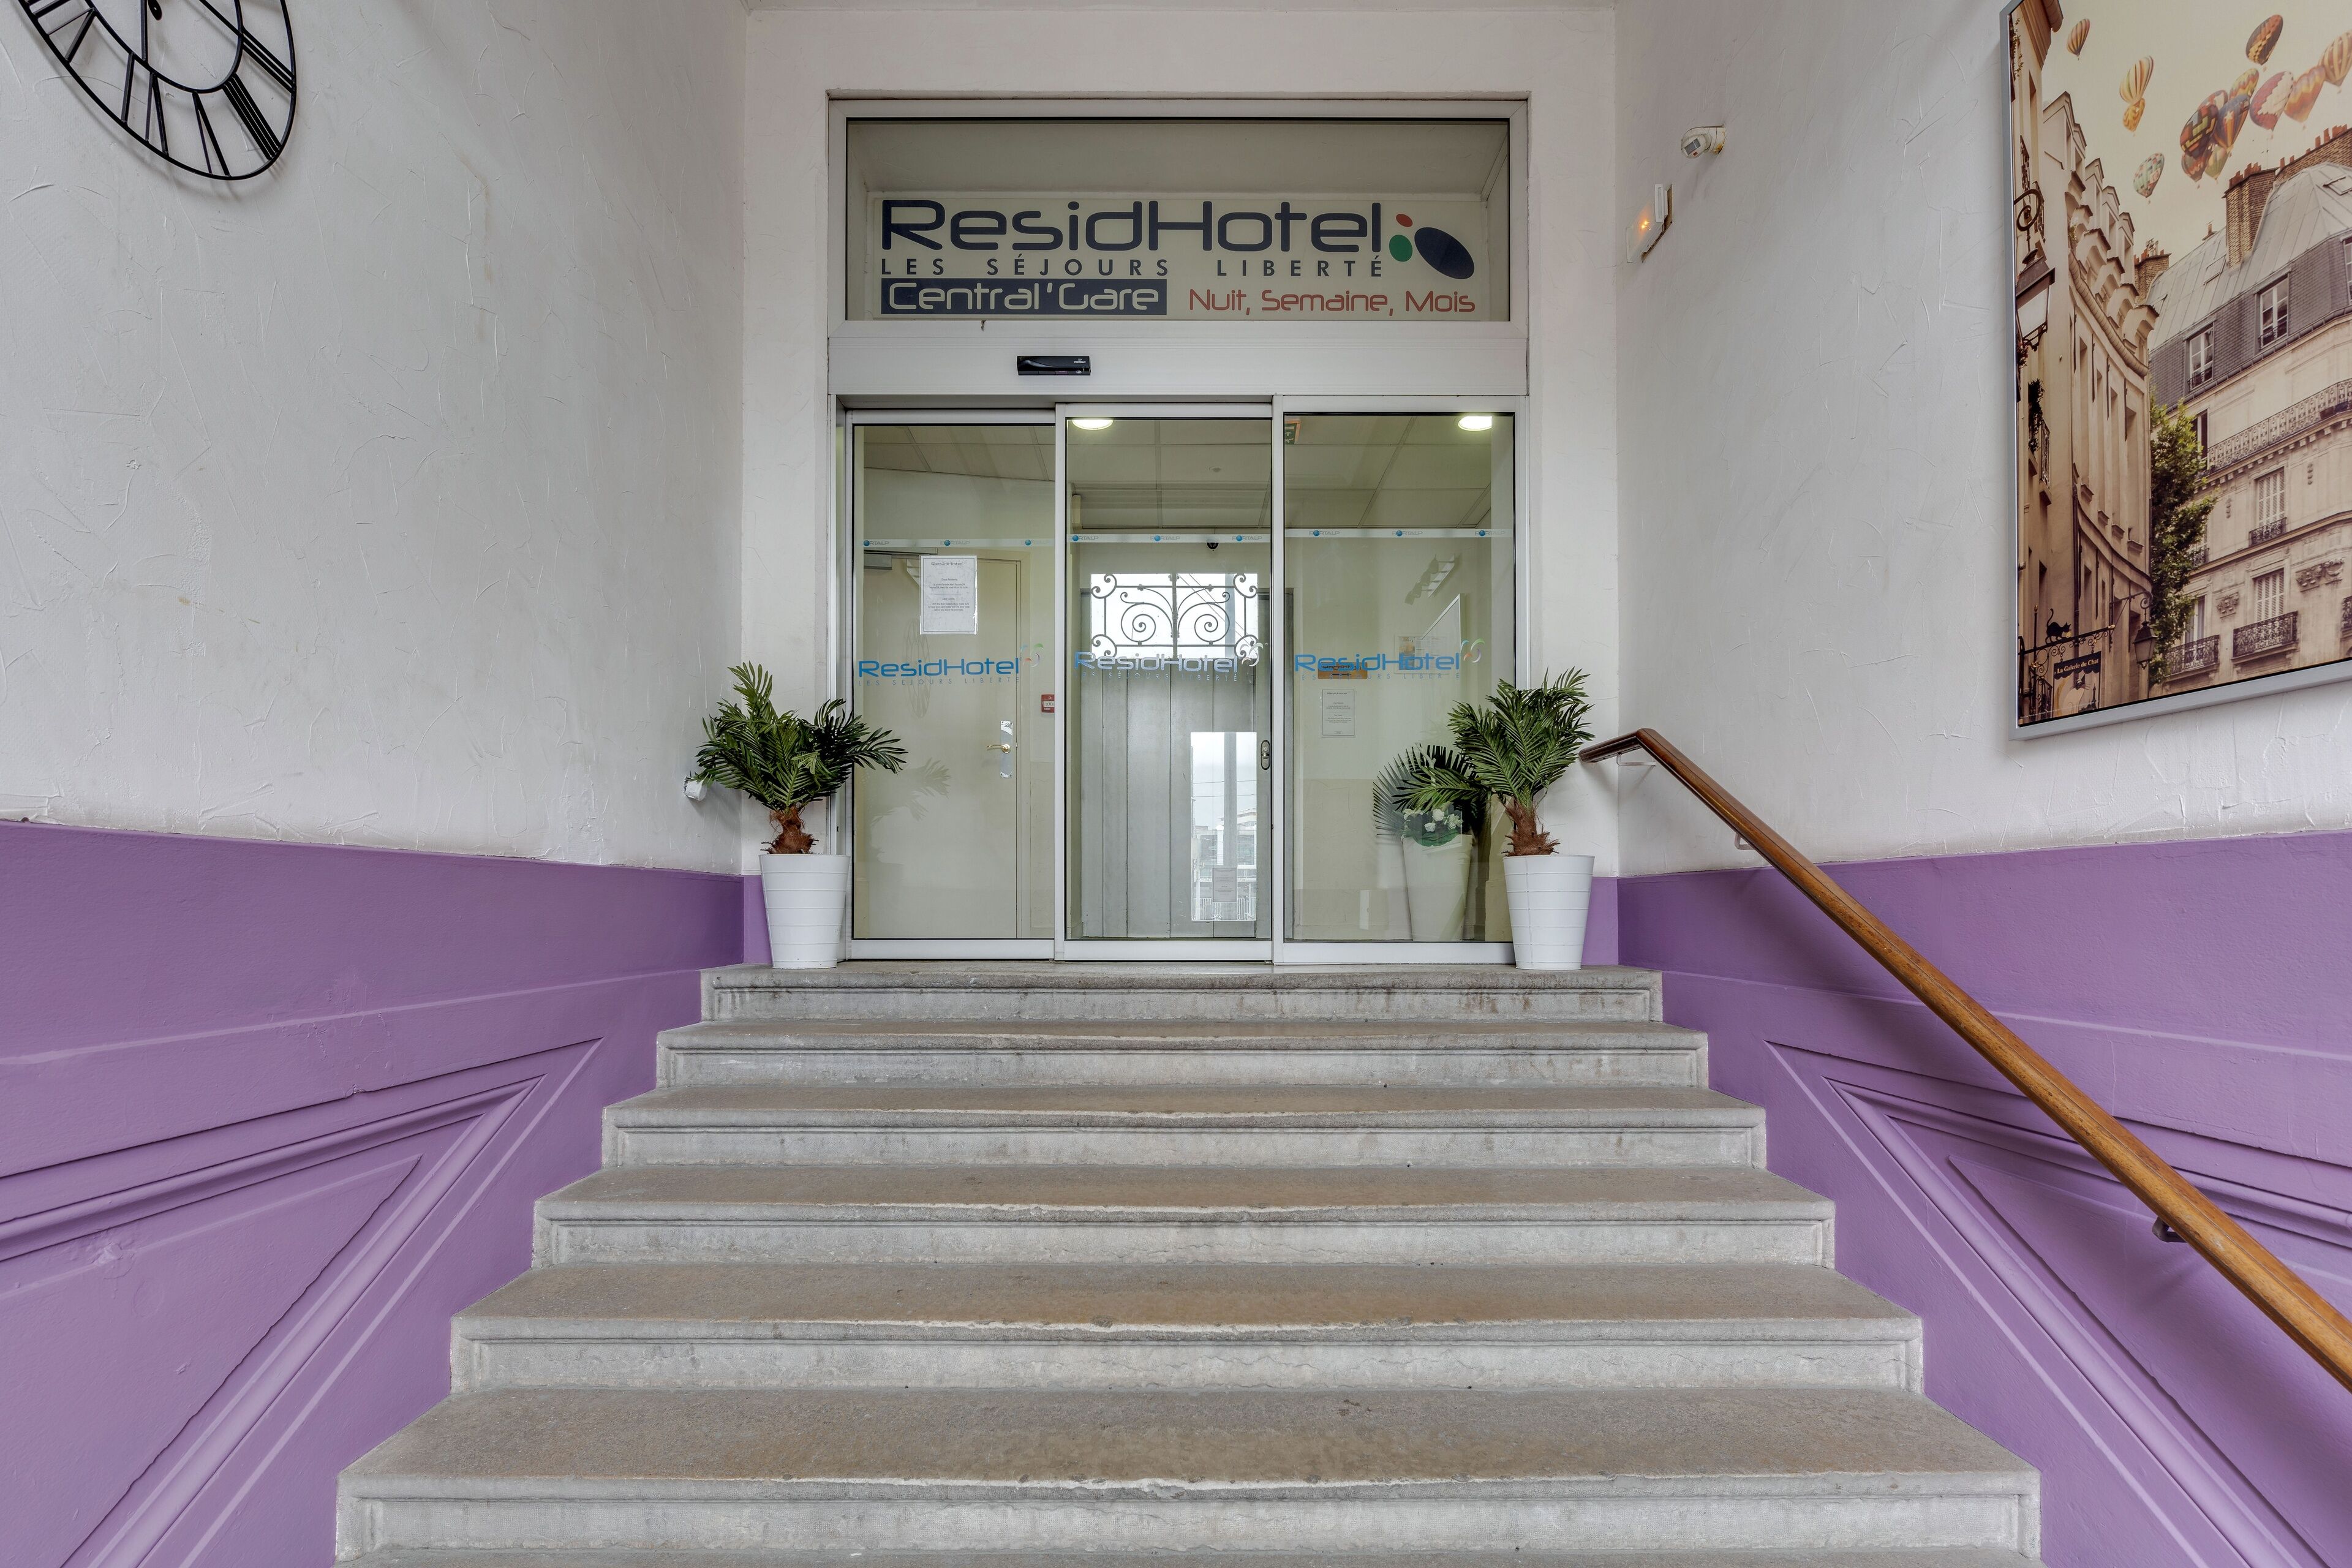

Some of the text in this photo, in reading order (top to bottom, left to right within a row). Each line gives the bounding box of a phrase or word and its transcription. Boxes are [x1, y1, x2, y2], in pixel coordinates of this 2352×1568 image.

[881, 200, 1381, 253] ResidHotel
[881, 253, 1382, 277] LES SÉJOURS LIBERTÉ
[1189, 288, 1251, 315] Nuit,
[1261, 289, 1394, 316] Semaine,
[1405, 290, 1476, 313] Mois
[858, 658, 1019, 677] ResidHotel
[1074, 651, 1238, 673] ResidHotel
[1294, 652, 1460, 672] ResidHotel
[2064, 663, 2081, 672] Galerie
